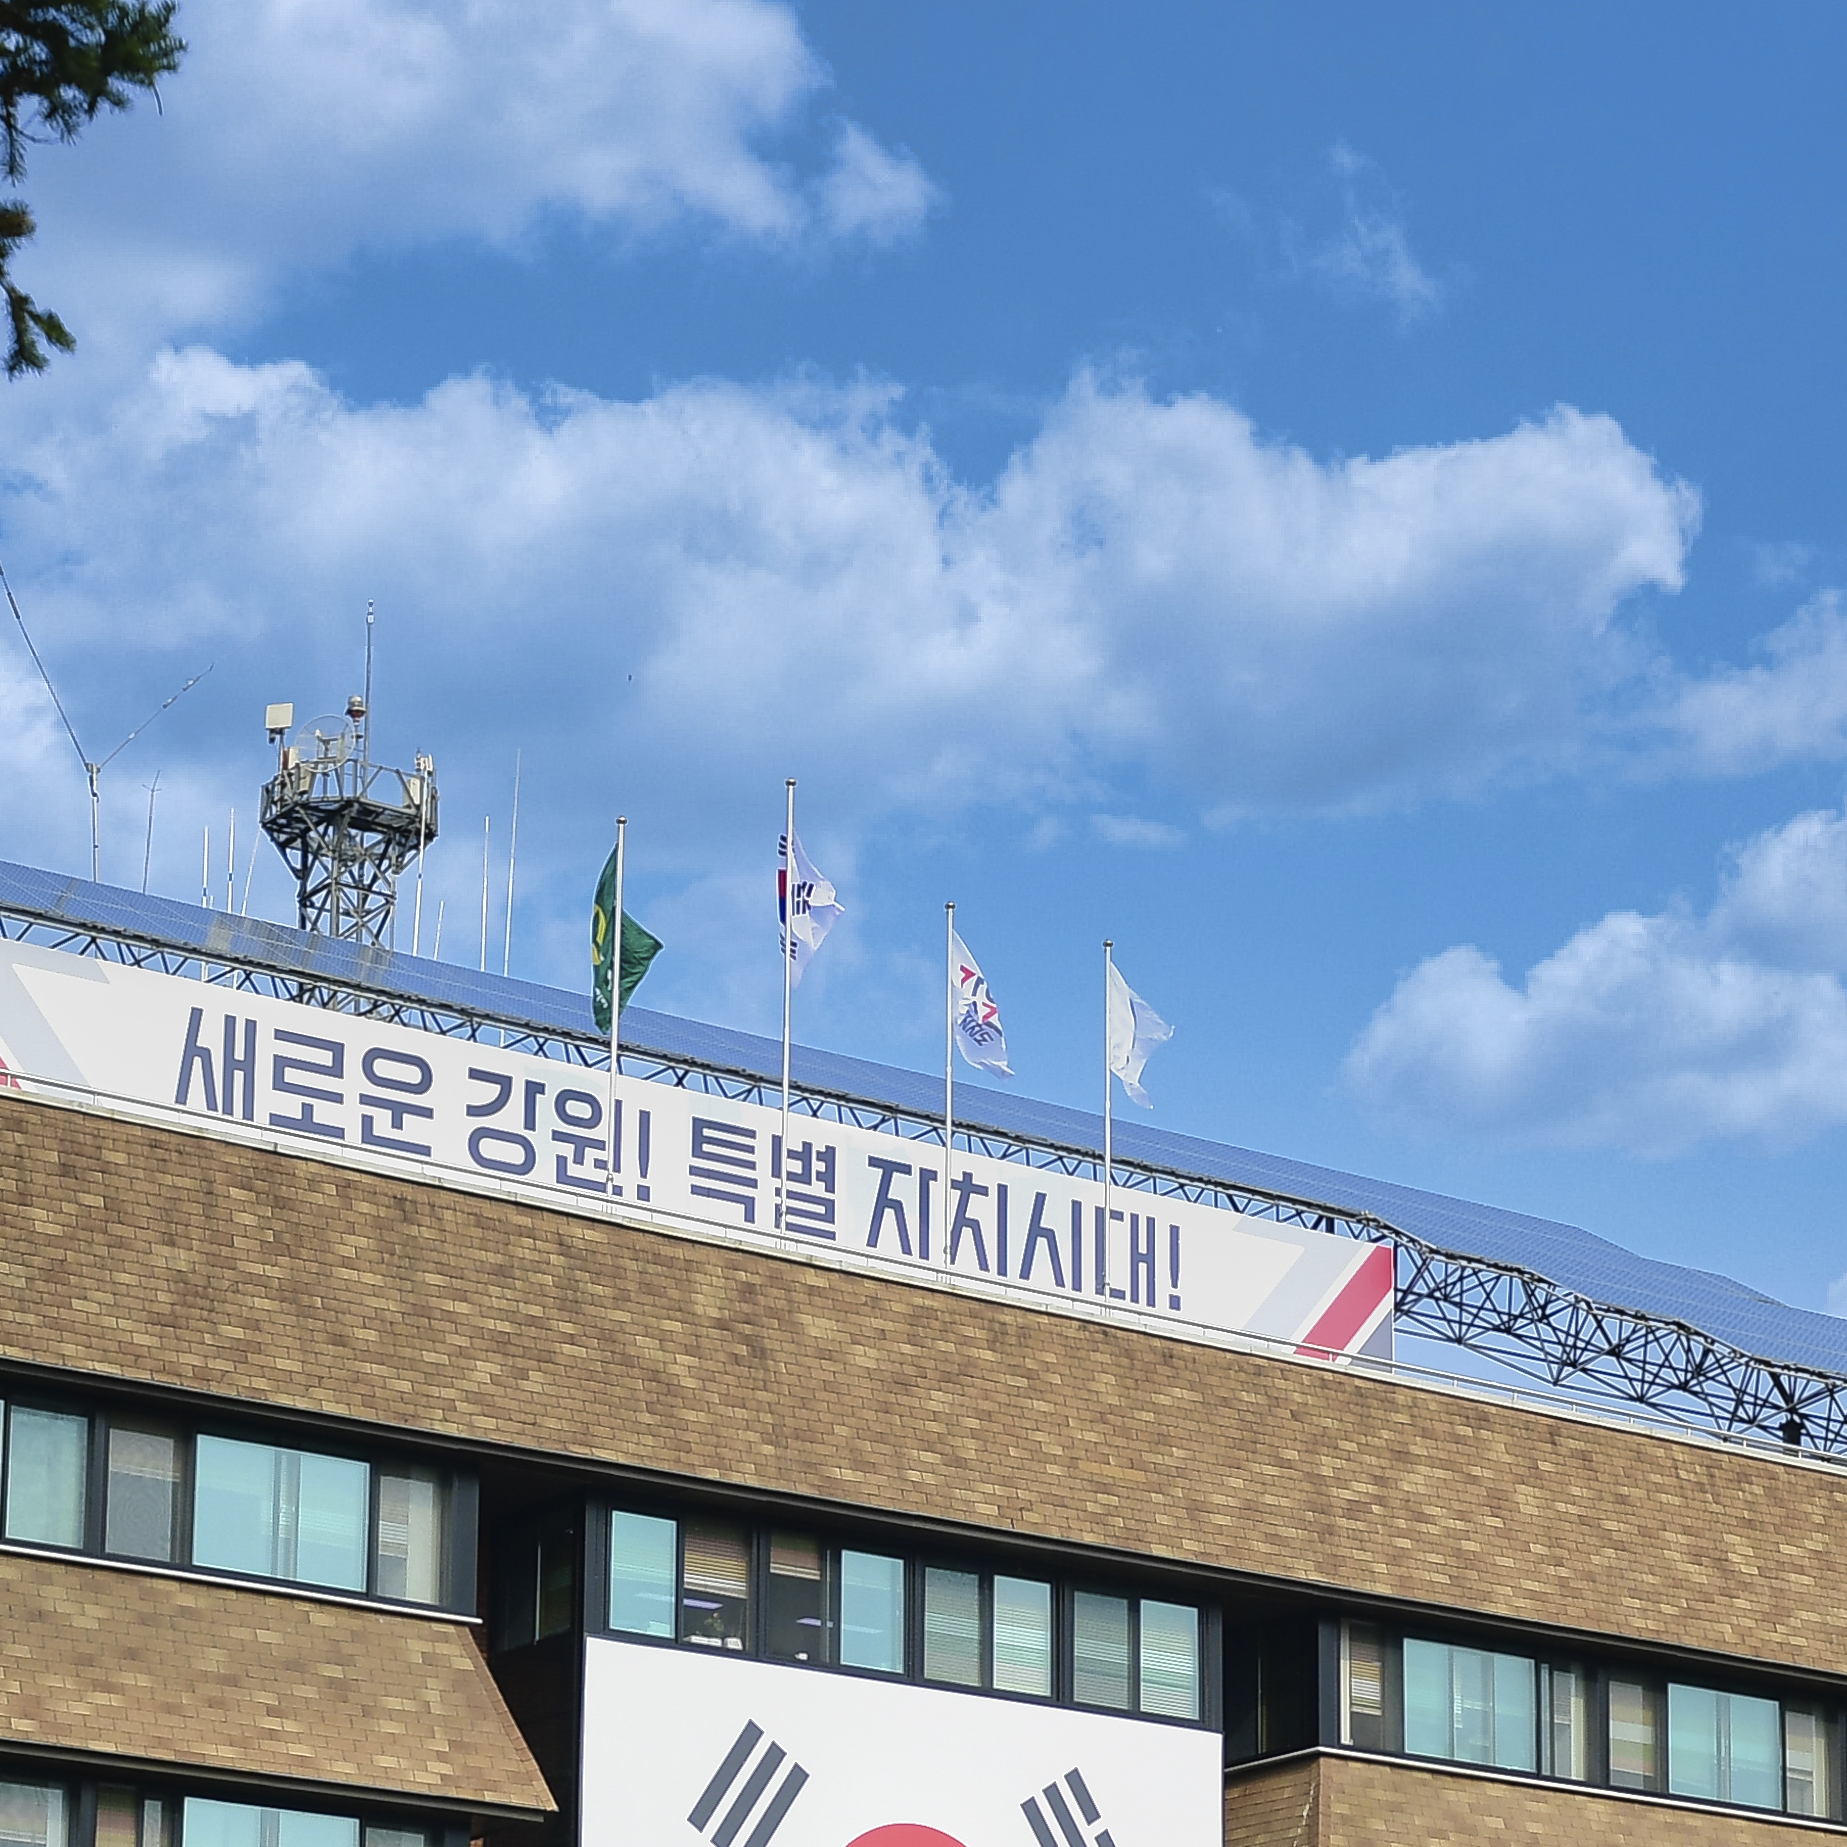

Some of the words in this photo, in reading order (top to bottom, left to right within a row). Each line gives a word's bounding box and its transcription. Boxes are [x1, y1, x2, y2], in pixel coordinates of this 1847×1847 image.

[174, 1005, 436, 1159] 새로운
[464, 1066, 653, 1203] 강원!
[688, 1115, 837, 1242] 특별
[865, 1154, 1182, 1311] 자치시대!
